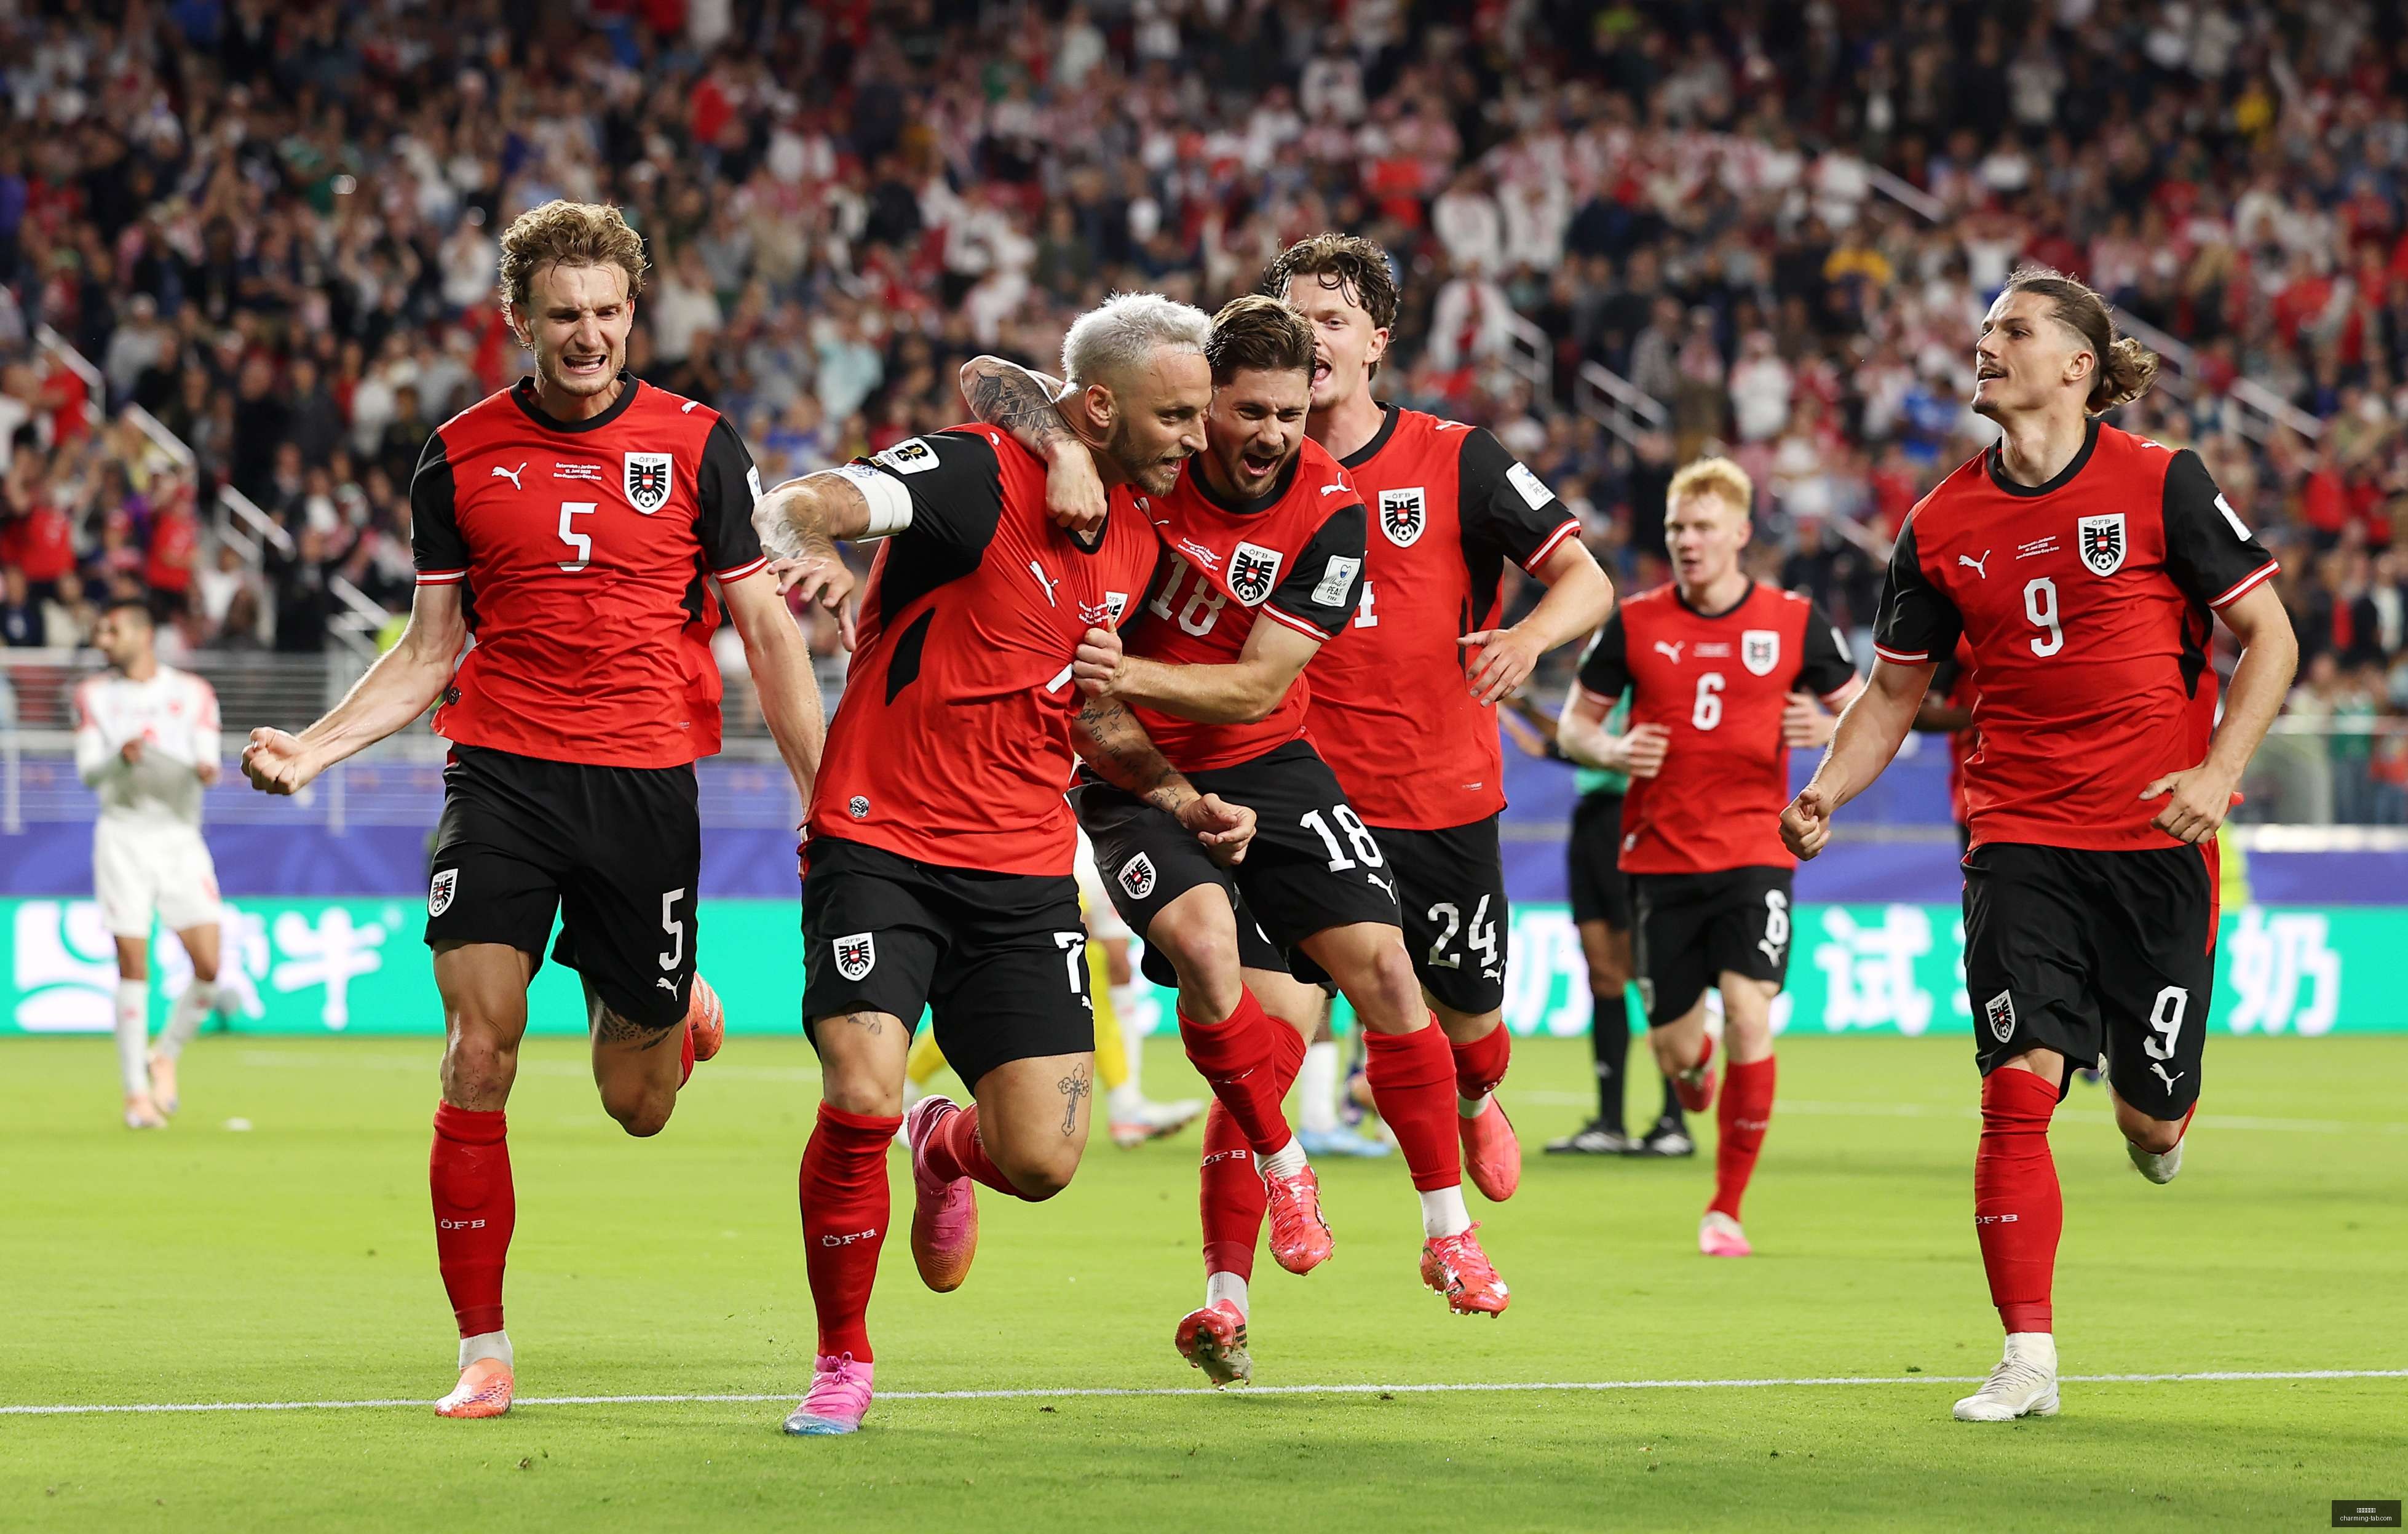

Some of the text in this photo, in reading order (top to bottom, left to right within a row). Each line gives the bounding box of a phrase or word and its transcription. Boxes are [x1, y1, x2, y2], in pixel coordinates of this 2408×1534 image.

[556, 502, 598, 571] 5
[1249, 548, 1268, 559] ÖFB
[1148, 552, 1227, 637] 18
[2023, 577, 2064, 658] 9
[1692, 672, 1726, 731] 6
[1299, 803, 1384, 872] 18
[659, 888, 685, 971] 5
[1428, 894, 1498, 969] 24
[1764, 889, 1789, 945] 6
[1053, 931, 1085, 993] 7
[2228, 904, 2340, 1035] 奶
[2143, 985, 2188, 1060] 9
[440, 1218, 485, 1230] ÖFB
[822, 1228, 877, 1247] ÖFB
